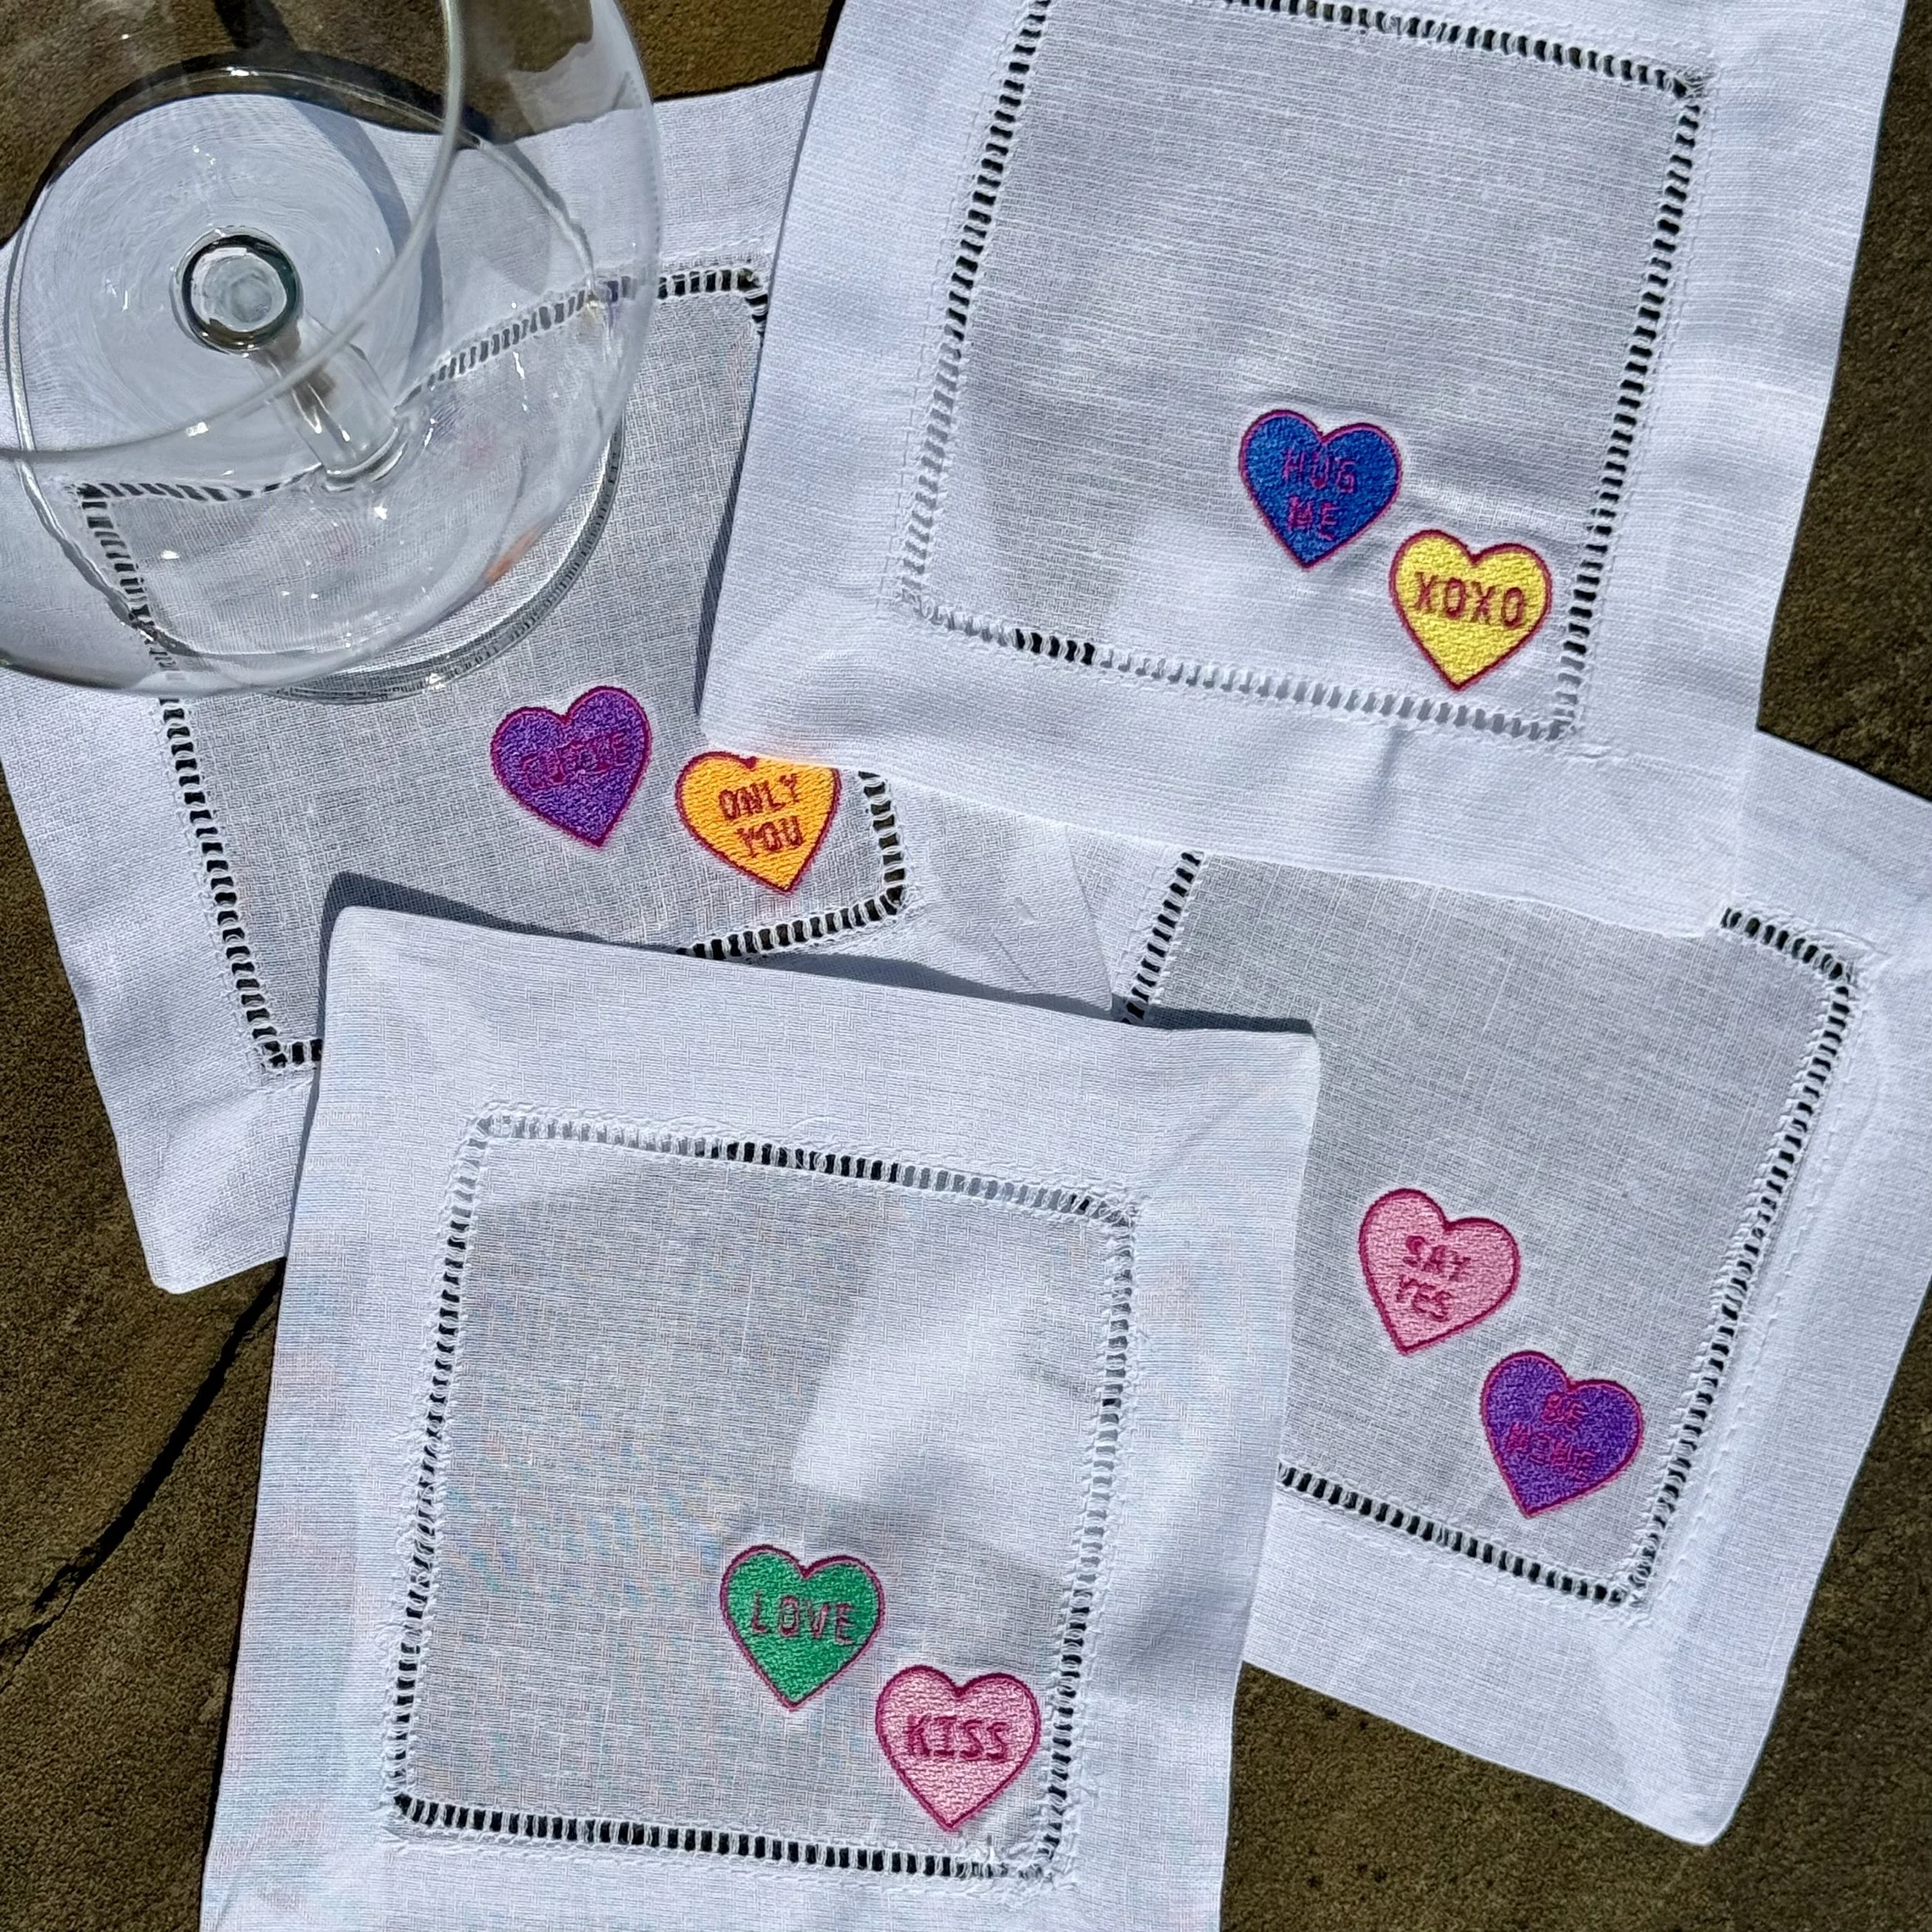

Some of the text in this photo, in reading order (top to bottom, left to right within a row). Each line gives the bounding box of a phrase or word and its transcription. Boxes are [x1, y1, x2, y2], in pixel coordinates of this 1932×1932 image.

[1282, 444, 1357, 493] HUG
[1287, 495, 1338, 539] ME
[1413, 570, 1525, 630] XOXO
[719, 772, 799, 820] ONLY
[736, 815, 802, 858] YOU
[1402, 1234, 1471, 1281] SAY
[1395, 1274, 1454, 1321] YES
[750, 1588, 855, 1645] LOVE
[906, 1713, 1011, 1764] KISS
